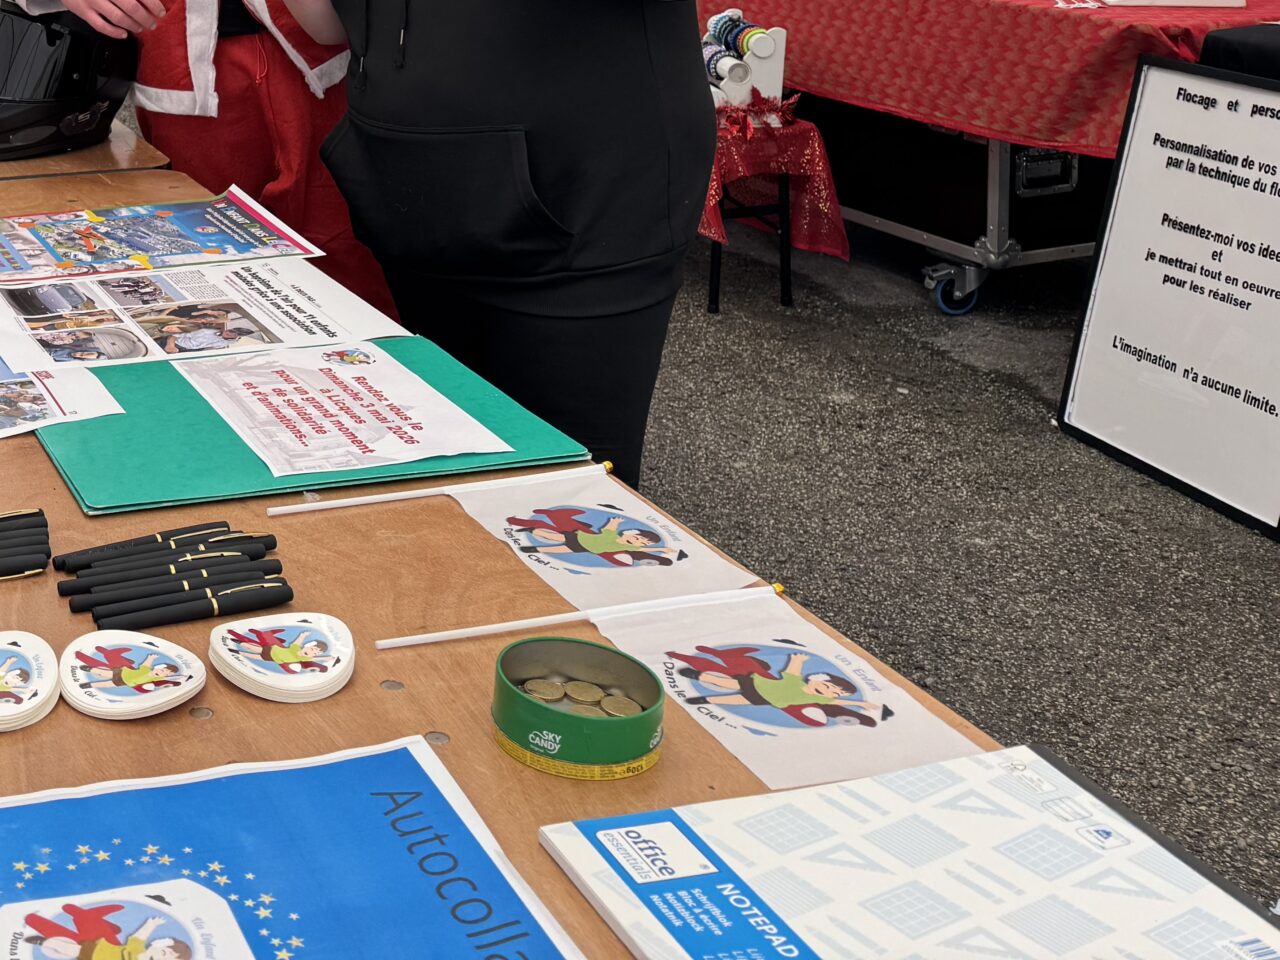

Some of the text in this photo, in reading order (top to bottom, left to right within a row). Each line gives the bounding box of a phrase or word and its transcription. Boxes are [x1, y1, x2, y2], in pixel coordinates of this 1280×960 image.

[1176, 87, 1218, 111] Flocage
[1227, 98, 1240, 112] et
[1153, 132, 1277, 176] Personnalisation de vos
[1166, 155, 1185, 170] par
[1186, 158, 1195, 173] la
[1198, 162, 1250, 189] technique
[1253, 177, 1268, 193] du
[1161, 212, 1235, 248] Présentez-moi
[1237, 238, 1256, 255] vos
[1145, 247, 1280, 300] je mettrai tout en oeuvre
[1211, 249, 1224, 263] et
[1162, 273, 1252, 311] pour les réaliser
[280, 309, 318, 336] association
[286, 301, 308, 315] pour
[310, 319, 338, 339] enfants
[242, 381, 260, 391] et
[1112, 335, 1279, 418] L'imagination n'a aucune limite.
[271, 386, 329, 436] de solidarité
[271, 368, 376, 456] pour un grand moment
[318, 367, 421, 446] Dimanche 3 mai 2026
[320, 387, 367, 426] à Licques
[351, 375, 424, 432] Rendez vous le
[663, 661, 680, 690] Dans
[674, 688, 687, 700] le
[528, 733, 562, 754] CANDY
[542, 730, 562, 744] SKY
[602, 832, 652, 881] essentials
[625, 829, 676, 877] office
[648, 893, 685, 929] Notatnik
[662, 892, 705, 934] Notizblock
[676, 890, 695, 910] Bloc
[700, 914, 724, 938] écrire
[690, 887, 734, 929] Schrijfblok
[715, 882, 800, 959] NOTEPAD
